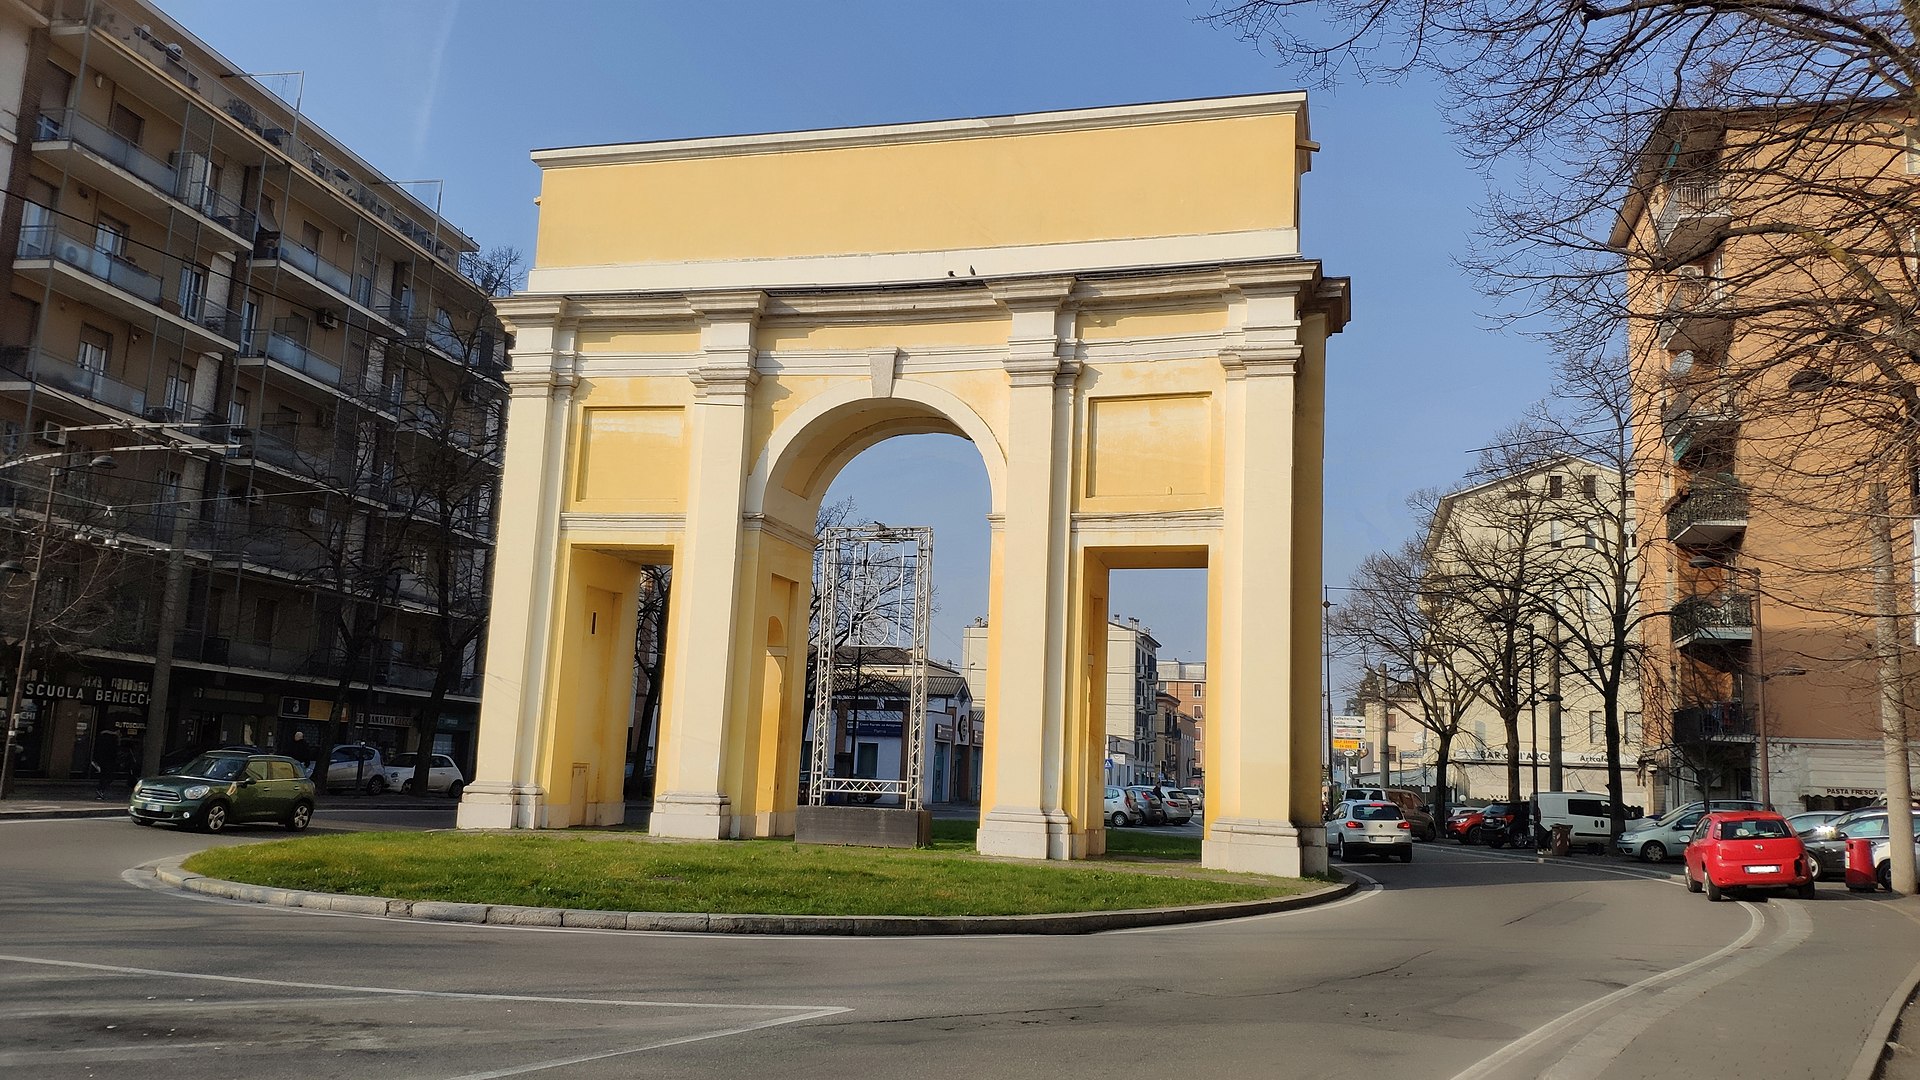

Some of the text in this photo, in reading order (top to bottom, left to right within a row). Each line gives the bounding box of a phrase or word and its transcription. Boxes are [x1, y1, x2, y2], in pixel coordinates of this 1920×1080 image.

[25, 682, 84, 700] SCUOLA
[1480, 750, 1501, 760] BAR
[1851, 788, 1879, 796] FRESCA
